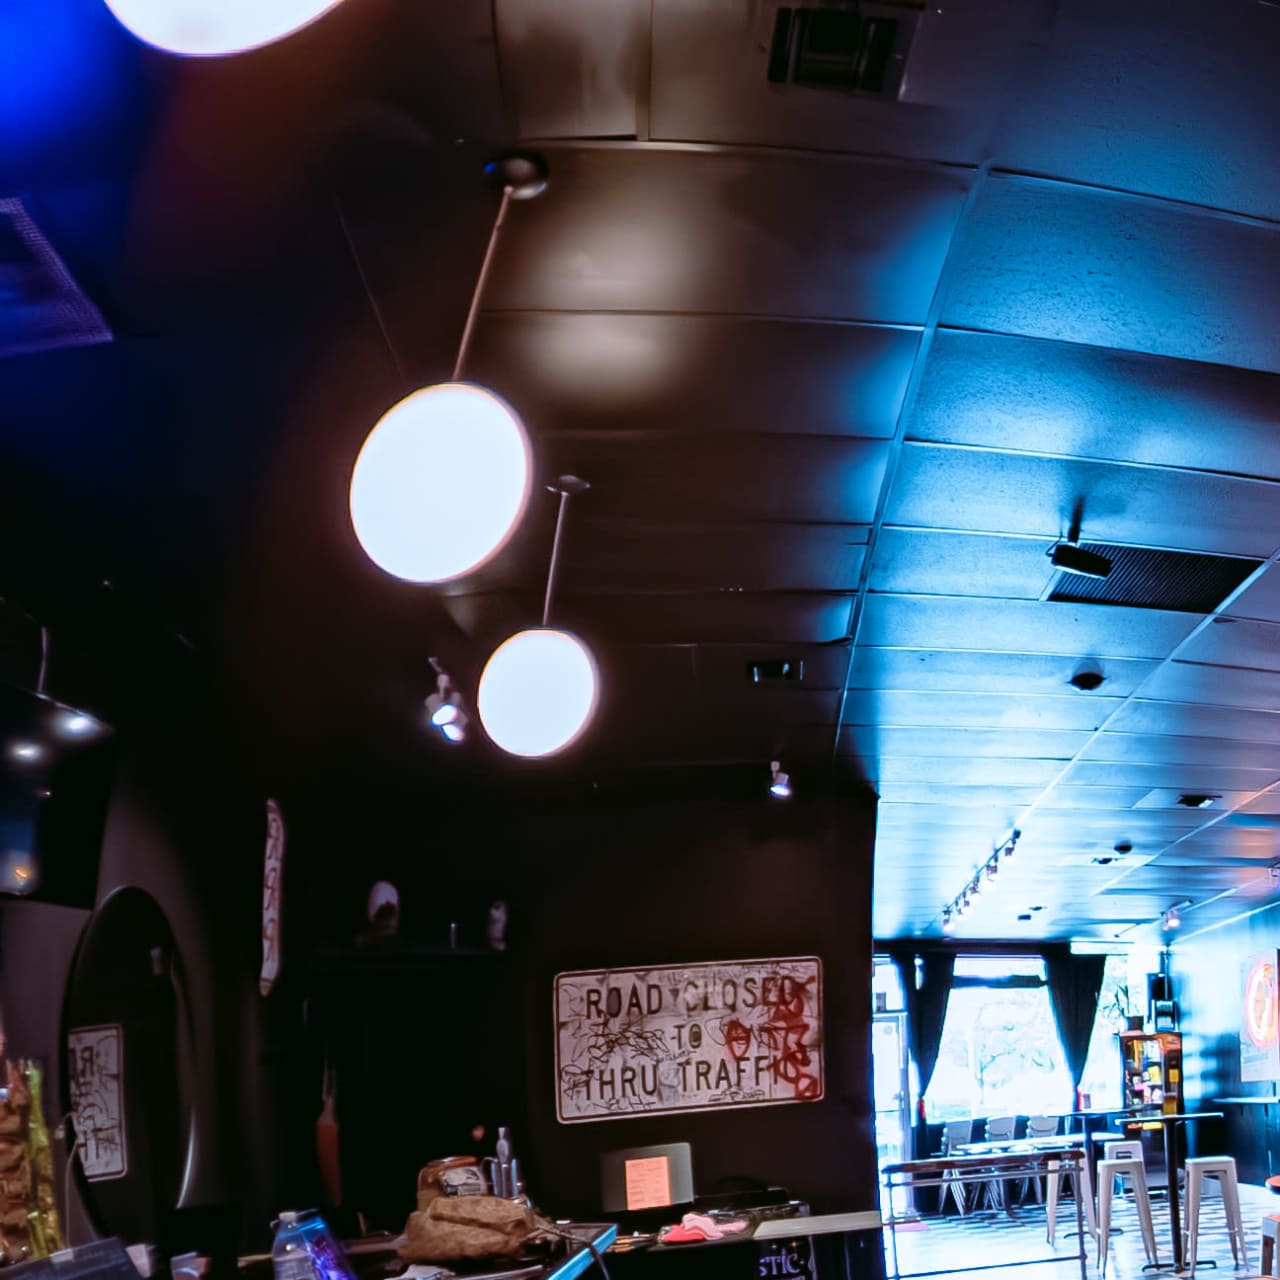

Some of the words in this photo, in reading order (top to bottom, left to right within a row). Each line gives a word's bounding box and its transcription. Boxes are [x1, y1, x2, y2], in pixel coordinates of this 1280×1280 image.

[586, 982, 663, 1019] ROAD
[685, 975, 798, 1012] CLOSED
[674, 1023, 702, 1050] TO
[582, 1064, 657, 1100] THRU
